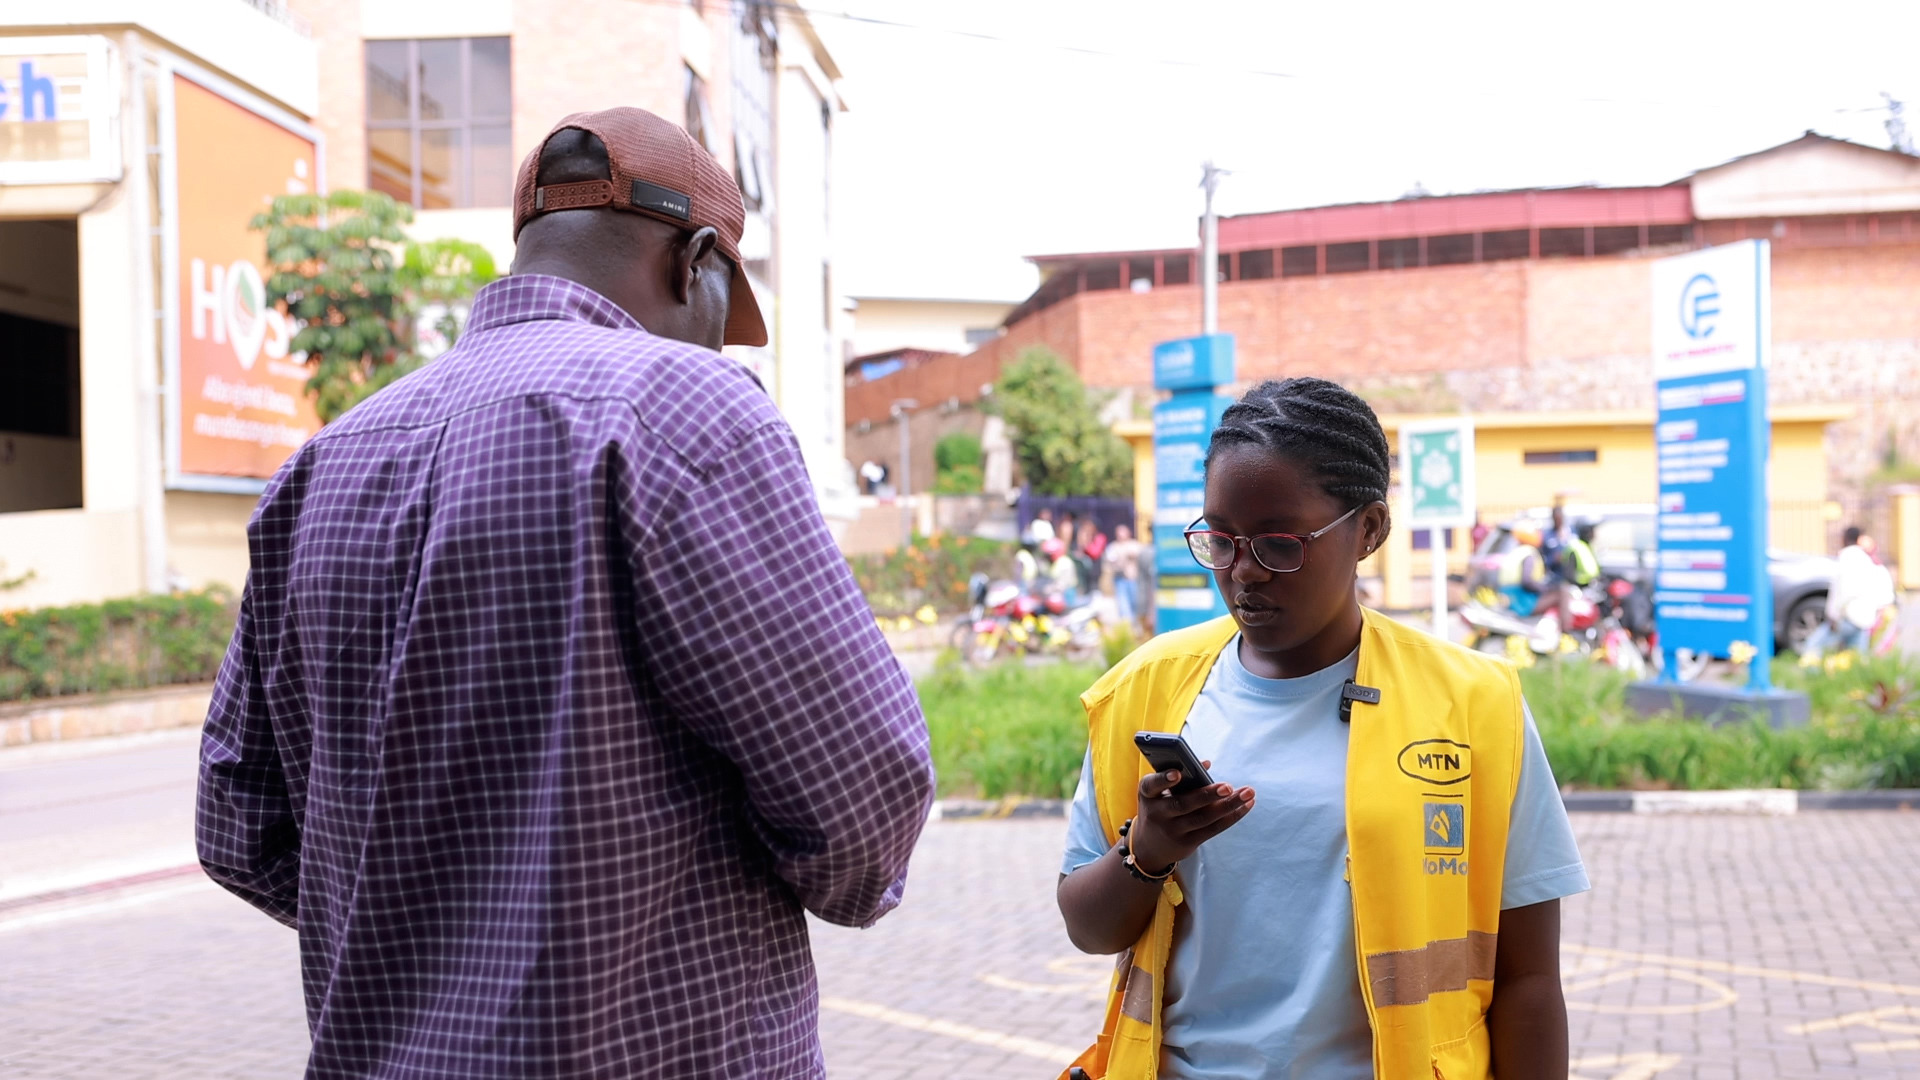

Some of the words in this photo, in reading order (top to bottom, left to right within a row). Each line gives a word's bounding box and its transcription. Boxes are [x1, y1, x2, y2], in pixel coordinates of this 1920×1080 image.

[0, 62, 55, 119] h
[662, 200, 686, 213] AMIRI
[1417, 753, 1460, 771] MTN
